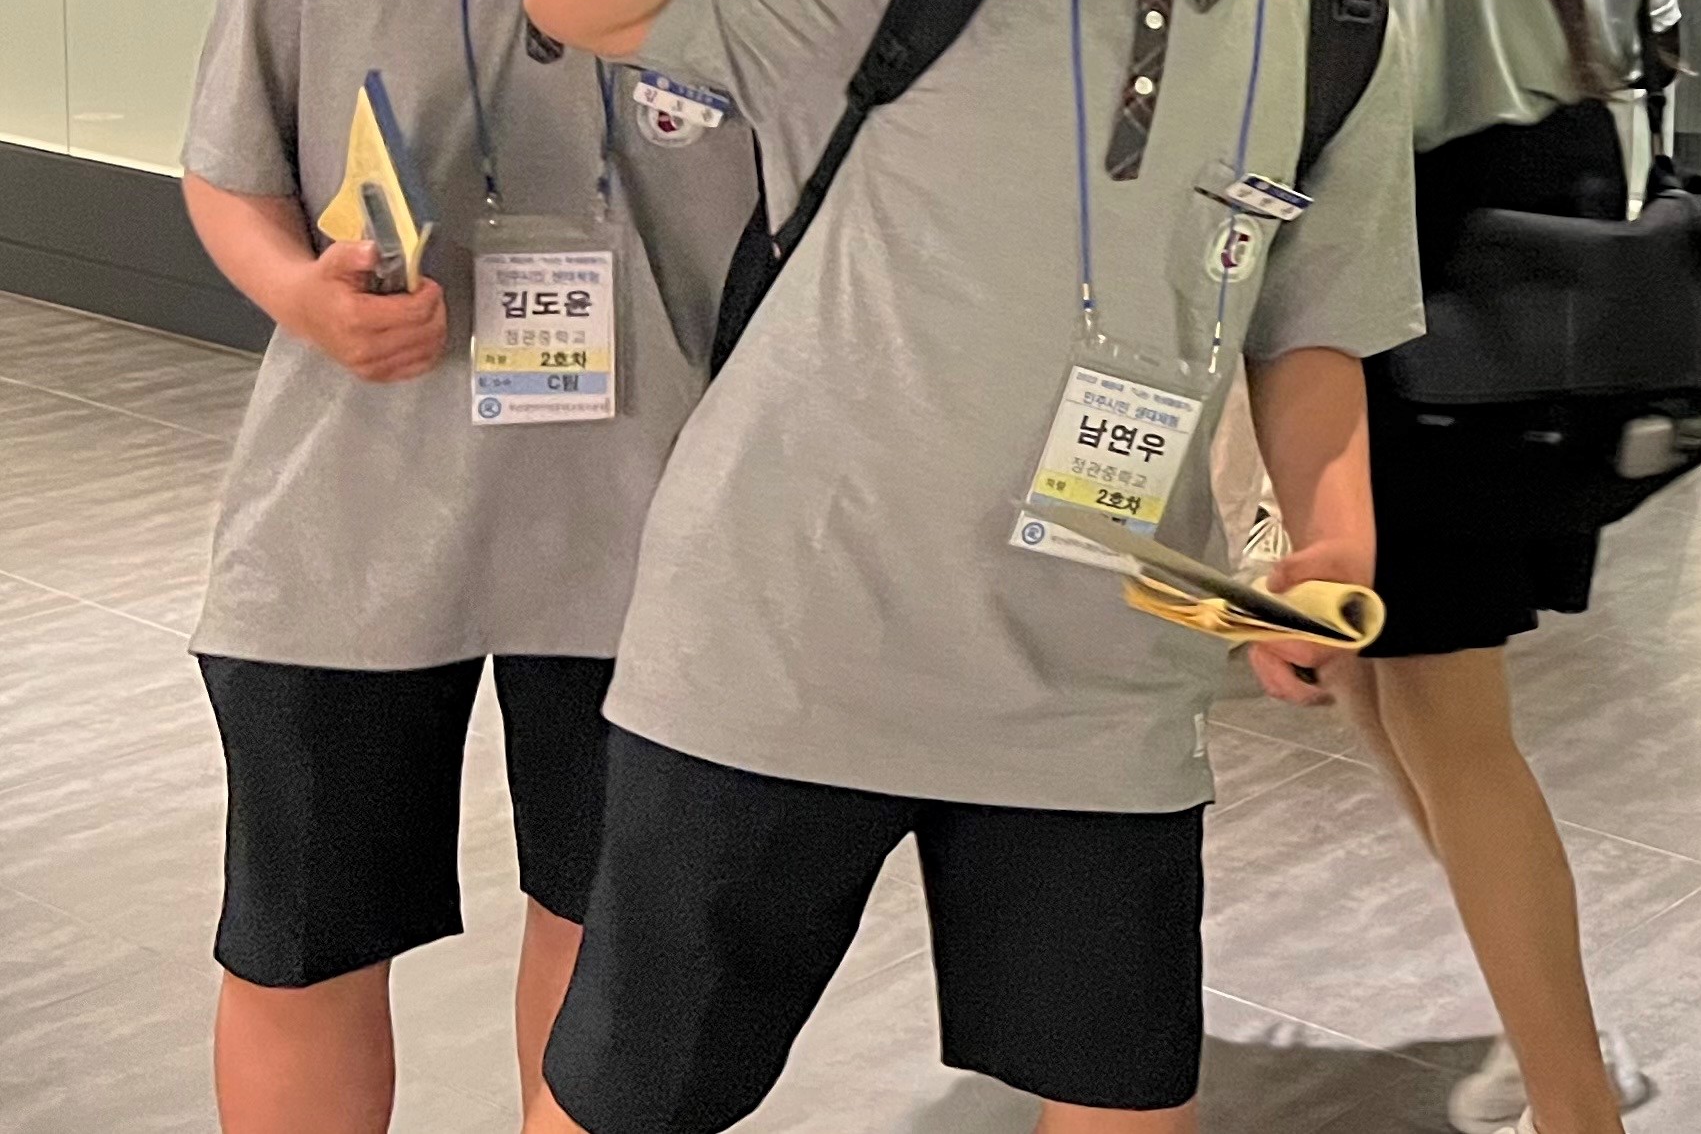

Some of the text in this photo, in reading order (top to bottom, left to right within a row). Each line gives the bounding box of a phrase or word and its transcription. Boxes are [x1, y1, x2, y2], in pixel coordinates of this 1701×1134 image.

[502, 290, 592, 319] 김도윤
[1077, 415, 1165, 463] 남연우
[1096, 488, 1142, 515] 2호차
